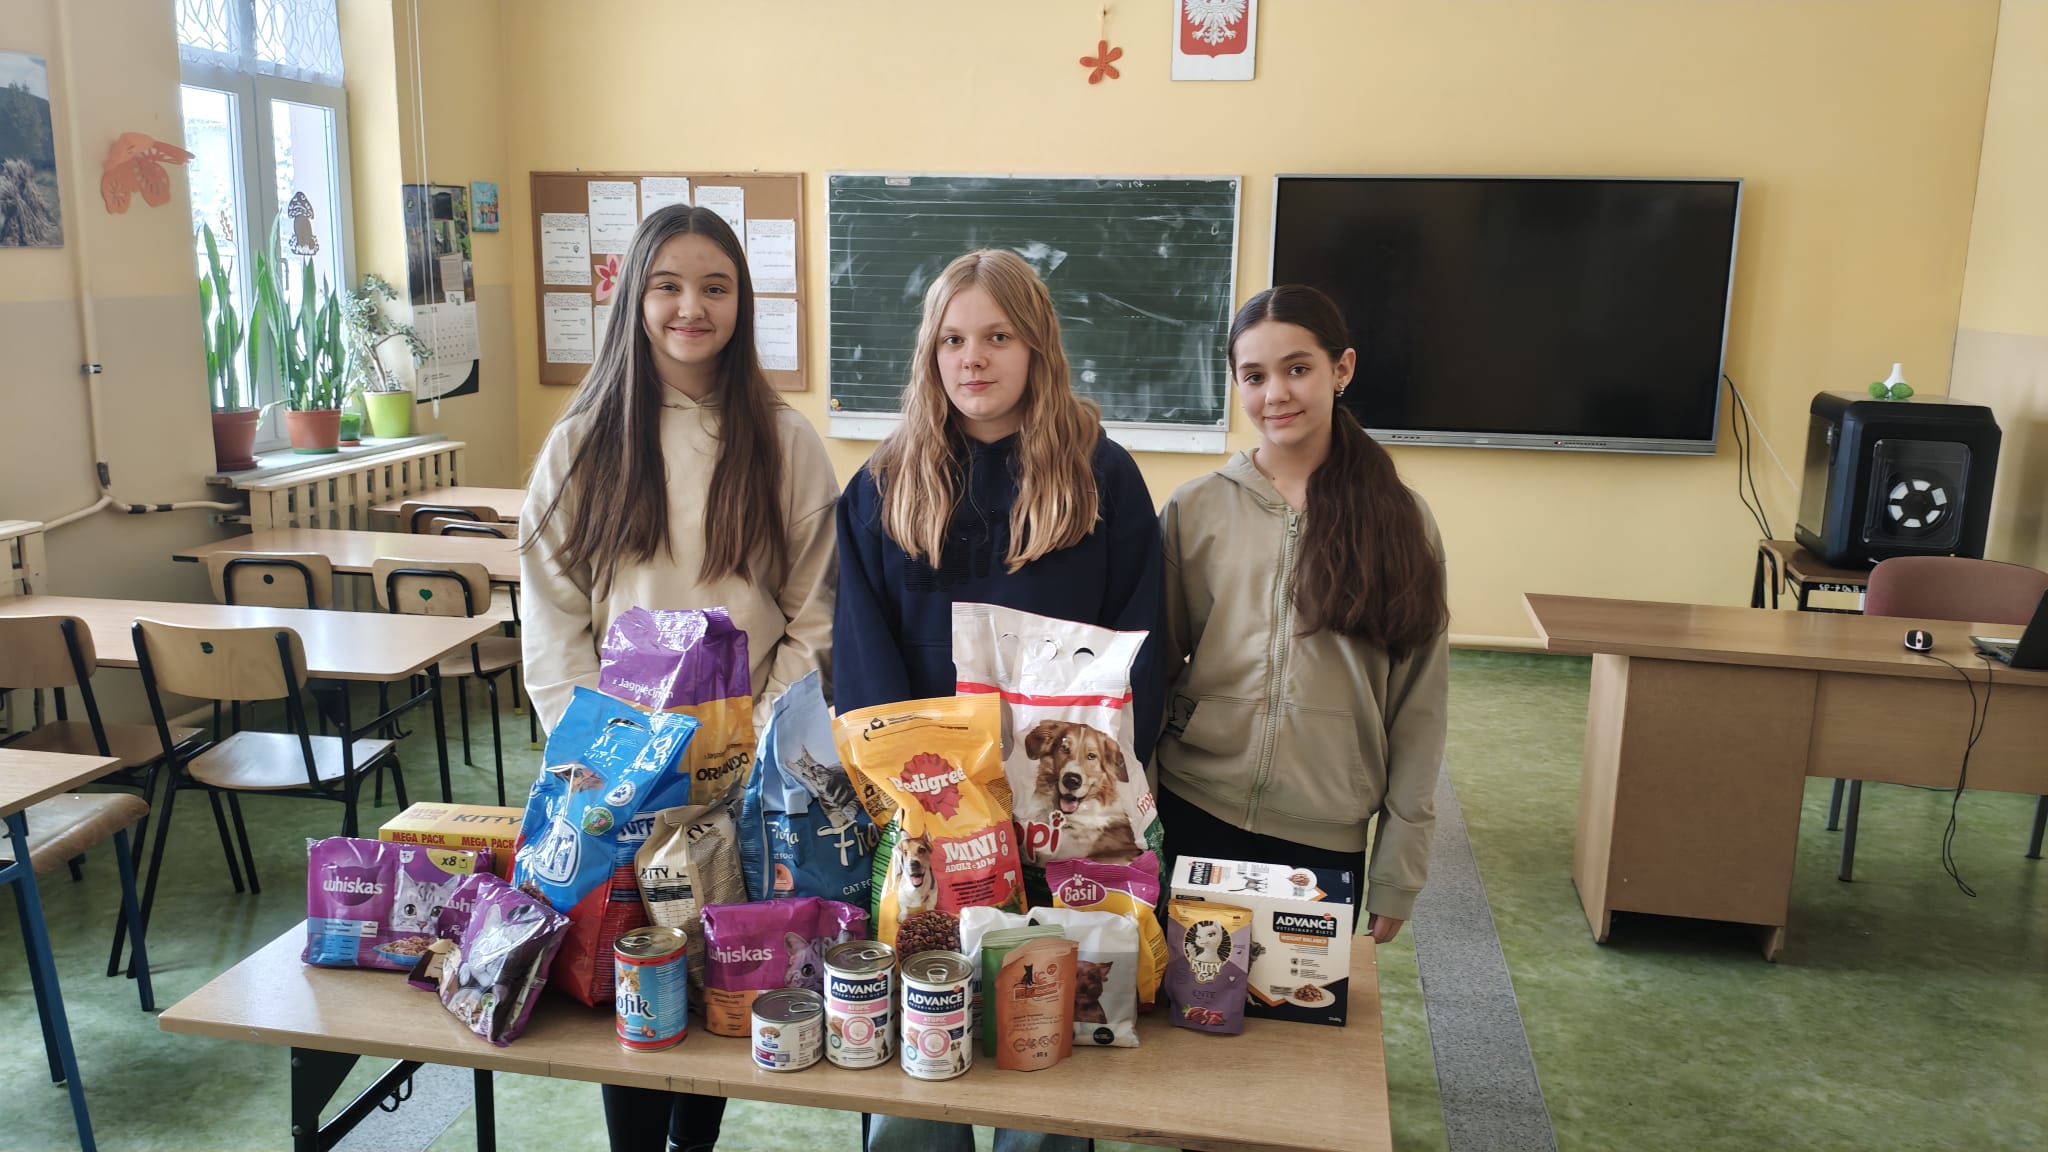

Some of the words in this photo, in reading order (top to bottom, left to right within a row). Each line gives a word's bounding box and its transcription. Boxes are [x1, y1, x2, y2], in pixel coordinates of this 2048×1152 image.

[888, 767, 967, 795] Pedigree
[454, 814, 521, 825] KITTY
[392, 831, 418, 843] MEGA
[421, 833, 445, 845] PACK
[461, 836, 487, 847] MEGA
[491, 838, 515, 849] PACK
[942, 831, 999, 863] MINI
[440, 855, 457, 867] x8
[323, 876, 384, 896] whiskas
[842, 883, 862, 896] CAT
[1064, 884, 1098, 903] Basil
[1276, 915, 1335, 931] ADVANCE
[709, 945, 773, 964] whiskas
[1191, 959, 1223, 974] KITTY
[831, 980, 887, 995] ADVANCE
[908, 992, 963, 1007] ADVANCE
